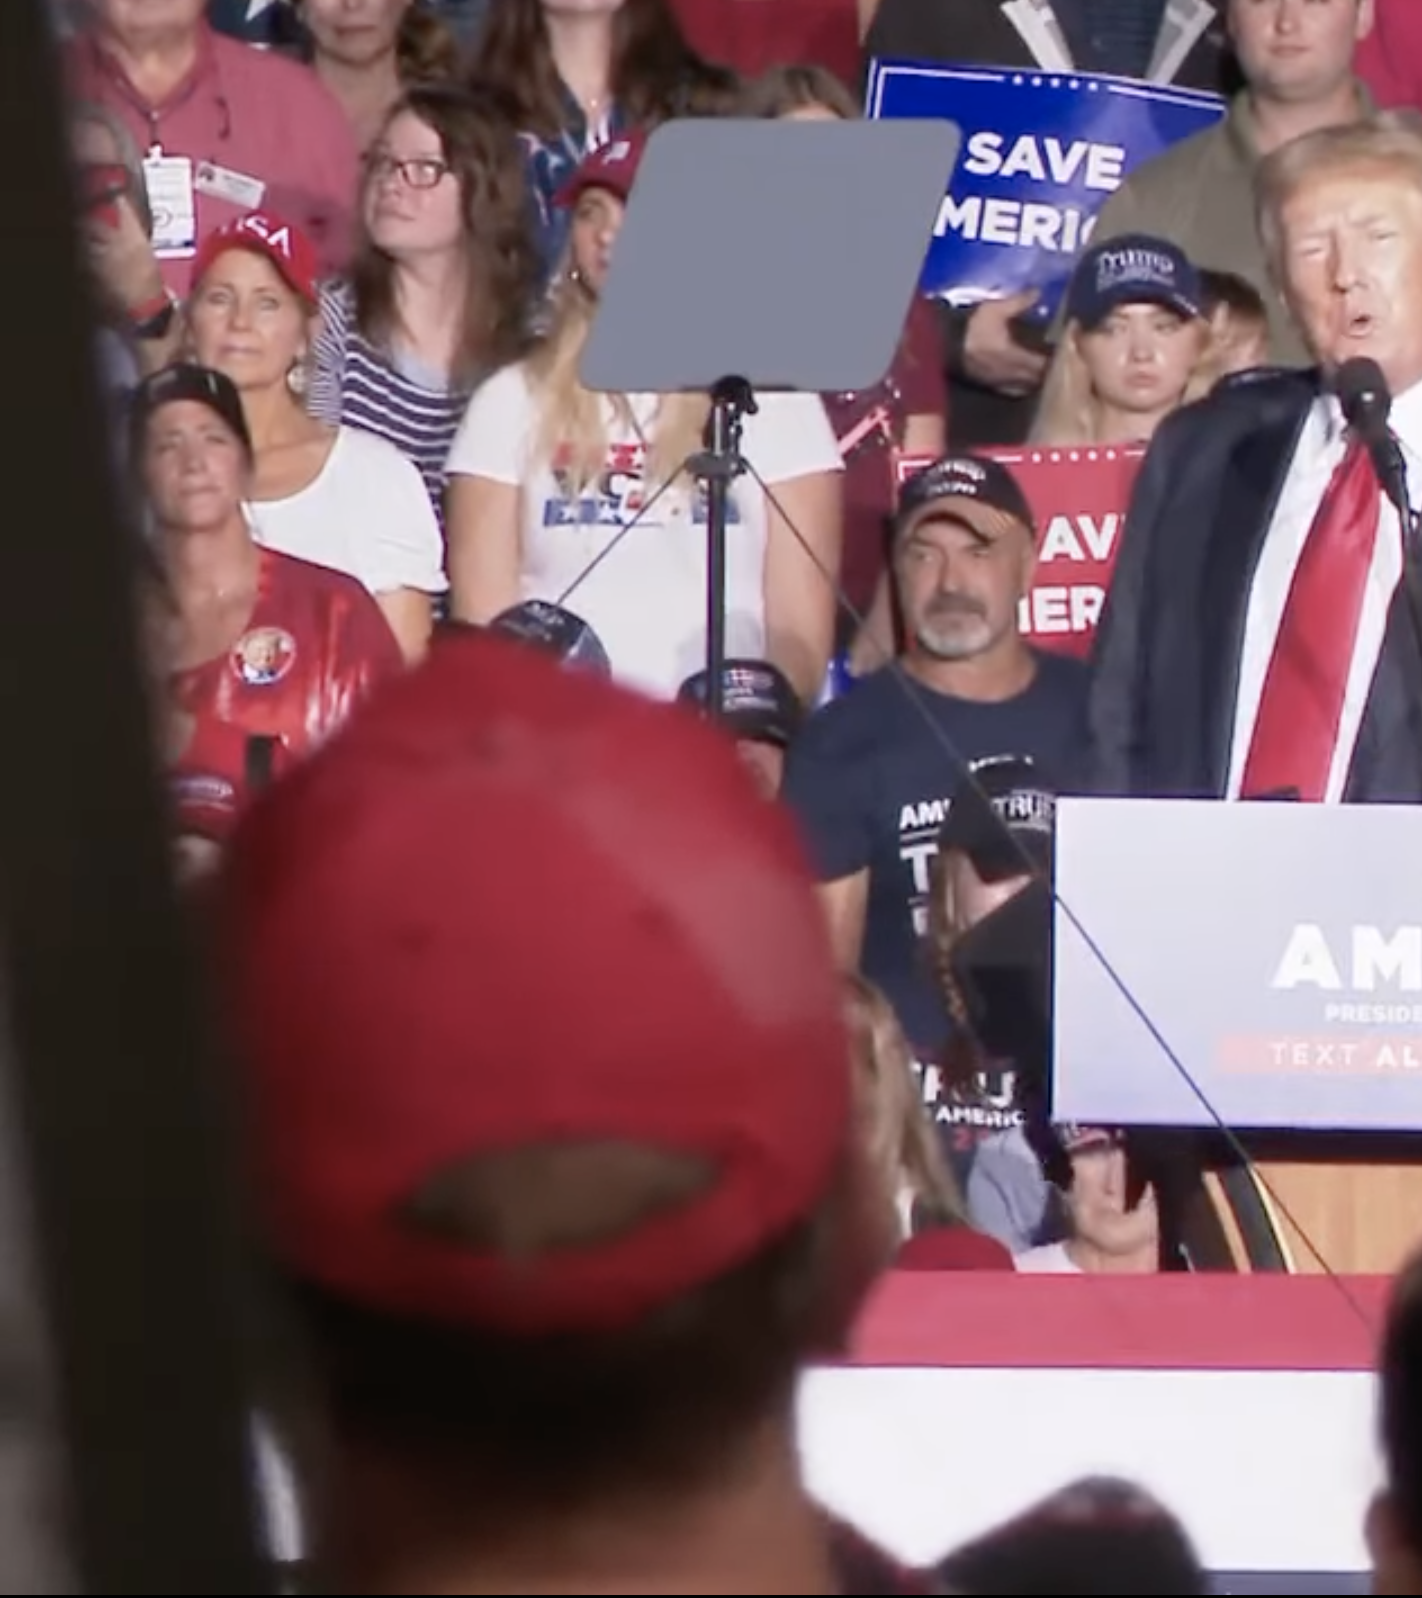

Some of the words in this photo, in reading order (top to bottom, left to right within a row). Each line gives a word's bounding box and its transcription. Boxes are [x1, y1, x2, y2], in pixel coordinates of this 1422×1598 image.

[964, 131, 1126, 191] SAVE
[933, 196, 1097, 253] MERI
[1039, 514, 1124, 561] AV
[1018, 586, 1105, 633] ER
[1270, 1042, 1358, 1066] TEXT
